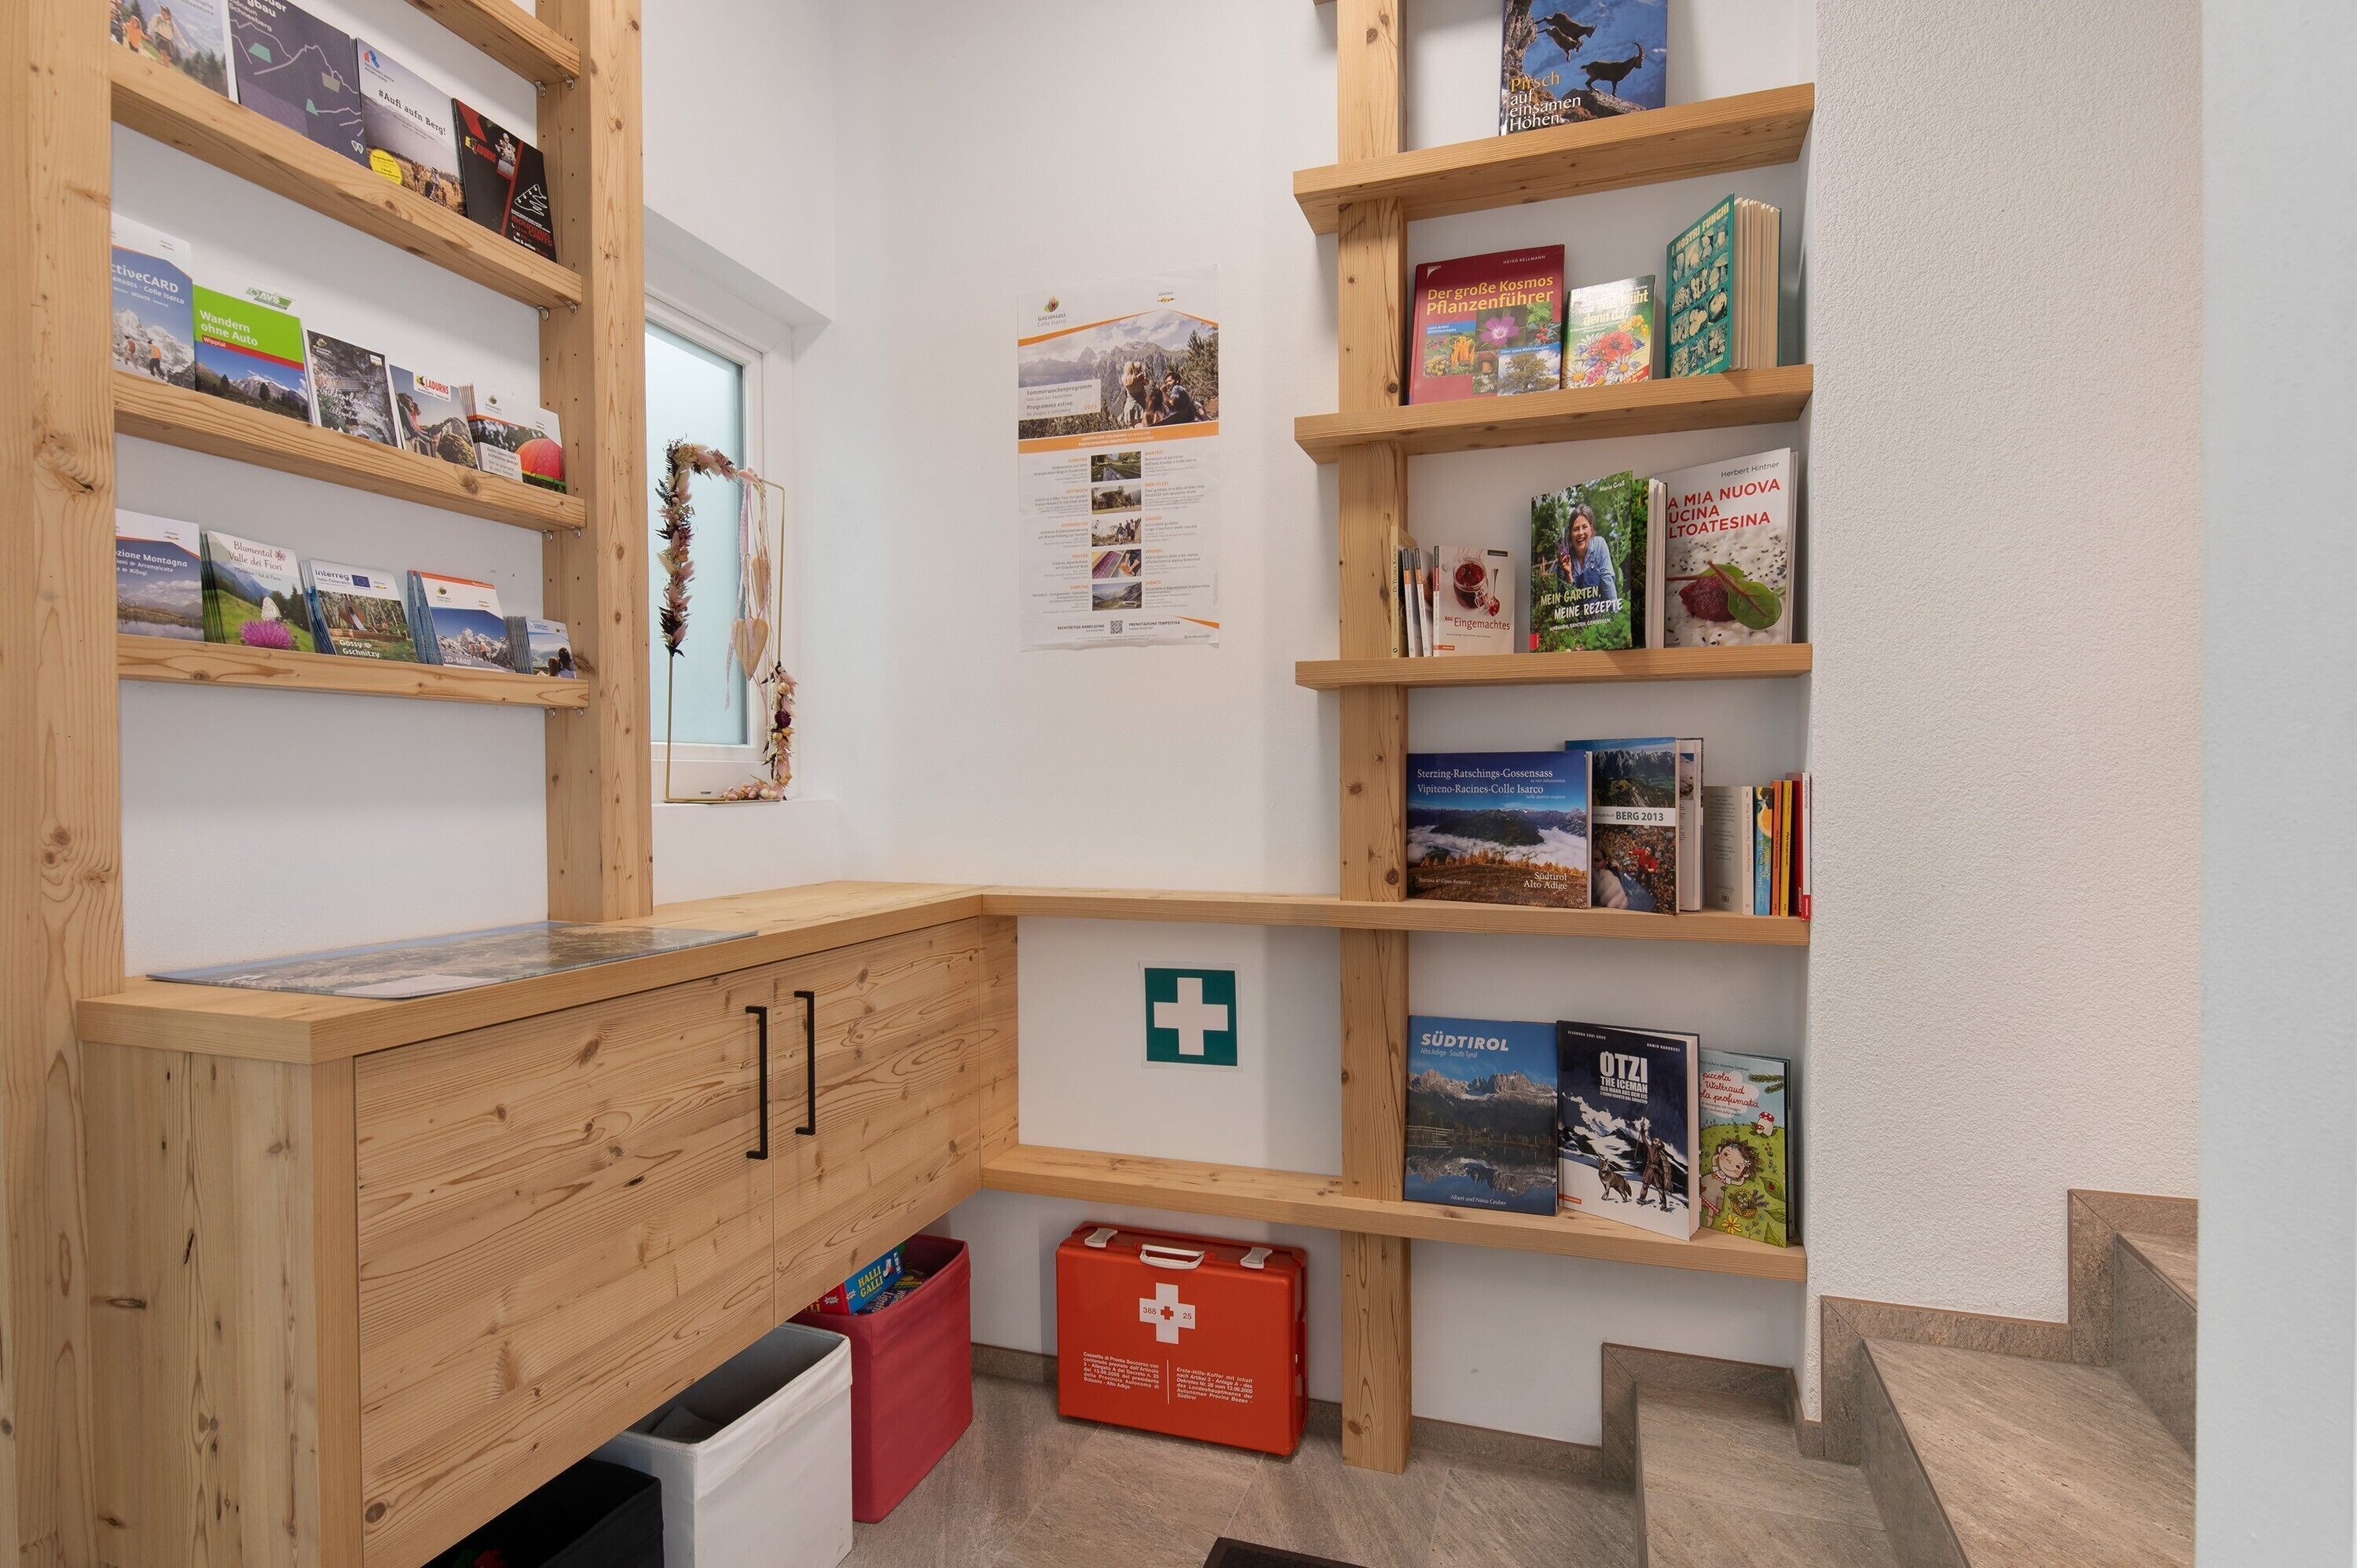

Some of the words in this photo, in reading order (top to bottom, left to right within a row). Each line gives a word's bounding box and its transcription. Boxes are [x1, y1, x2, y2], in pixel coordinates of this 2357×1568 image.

[229, 3, 273, 31] Schneeberg
[1510, 70, 1561, 93] Pirsch
[1510, 88, 1535, 107] auf
[379, 89, 402, 108] #Aufi
[404, 104, 423, 122] aufn
[424, 116, 446, 135] Berg!
[1509, 96, 1582, 118] einsamen
[1676, 226, 1701, 251] NOSTRI
[1702, 201, 1729, 233] FUNGHI
[143, 285, 163, 298] Colle
[163, 291, 185, 305] Isarco
[1428, 289, 1452, 301] Der
[1454, 282, 1496, 301] große
[1499, 277, 1553, 292] Kosmos
[1427, 290, 1554, 316] Pflanzenführer
[200, 310, 251, 333] Wandern
[1037, 313, 1067, 322] Gossensass
[200, 323, 229, 338] ohne
[232, 331, 258, 346] Auto
[203, 336, 227, 348] Wipptal
[425, 378, 449, 395] LADURNS
[1026, 383, 1093, 396] Sommerwochenprogramm
[1721, 467, 1749, 478] Herbert
[1751, 460, 1780, 473] Hintner
[1600, 484, 1612, 493] Maria
[1612, 480, 1626, 489] Groß
[1667, 496, 1678, 510] A
[1684, 490, 1714, 507] MIA
[1719, 478, 1780, 501] NUOVA
[1669, 504, 1721, 525] UCINA
[1669, 511, 1771, 540] LTOATESINA
[233, 540, 273, 559] Blumental
[137, 562, 174, 573] Arrampicate
[142, 553, 189, 568] Montagna
[227, 551, 248, 564] Valle
[250, 557, 262, 567] dei
[263, 559, 283, 572] Fiori
[129, 568, 148, 577] Rifugi
[315, 569, 350, 581] Interreg
[1541, 592, 1561, 606] MEIN
[1563, 586, 1601, 603] GARTEN,
[1554, 605, 1581, 620] MEINE
[1583, 599, 1624, 616] REZEPTE
[1454, 617, 1511, 631] Eingemachtes
[339, 639, 362, 649] Gossy
[342, 647, 381, 659] Gschnitzy
[444, 655, 471, 665] 3D-Map
[1417, 768, 1553, 780] Sterzing-Ratschings-Gossensass
[1417, 784, 1515, 795] Vipiteno-Racines-Colle
[1517, 784, 1544, 793] Isarco
[1615, 811, 1639, 821] BERG
[1640, 812, 1664, 822] 2013
[1535, 872, 1567, 881] Südtirol
[1524, 880, 1542, 888] Alto
[1543, 881, 1567, 891] Adige
[1420, 1031, 1508, 1051] SÜDTIROL
[1464, 1050, 1478, 1059] Tyrol
[1600, 1051, 1648, 1084] ÖTZI
[1702, 1072, 1732, 1081] piccola
[1600, 1076, 1615, 1087] THE
[1617, 1079, 1648, 1094] ICEMAN
[1705, 1081, 1745, 1095] Waltraud
[1713, 1094, 1760, 1108] profumata
[1490, 1198, 1507, 1207] Gruber
[858, 1265, 882, 1288] HALLI
[860, 1276, 883, 1298] GALLI
[1083, 1351, 1103, 1360] Cassetta
[1177, 1367, 1224, 1379] Erste-Hilfe-Koffer
[1098, 1374, 1123, 1383] Provincia
[1125, 1379, 1152, 1388] Autonoma
[1177, 1387, 1207, 1397] Autonomen
[1189, 1384, 1241, 1397] Landeshauptmanns
